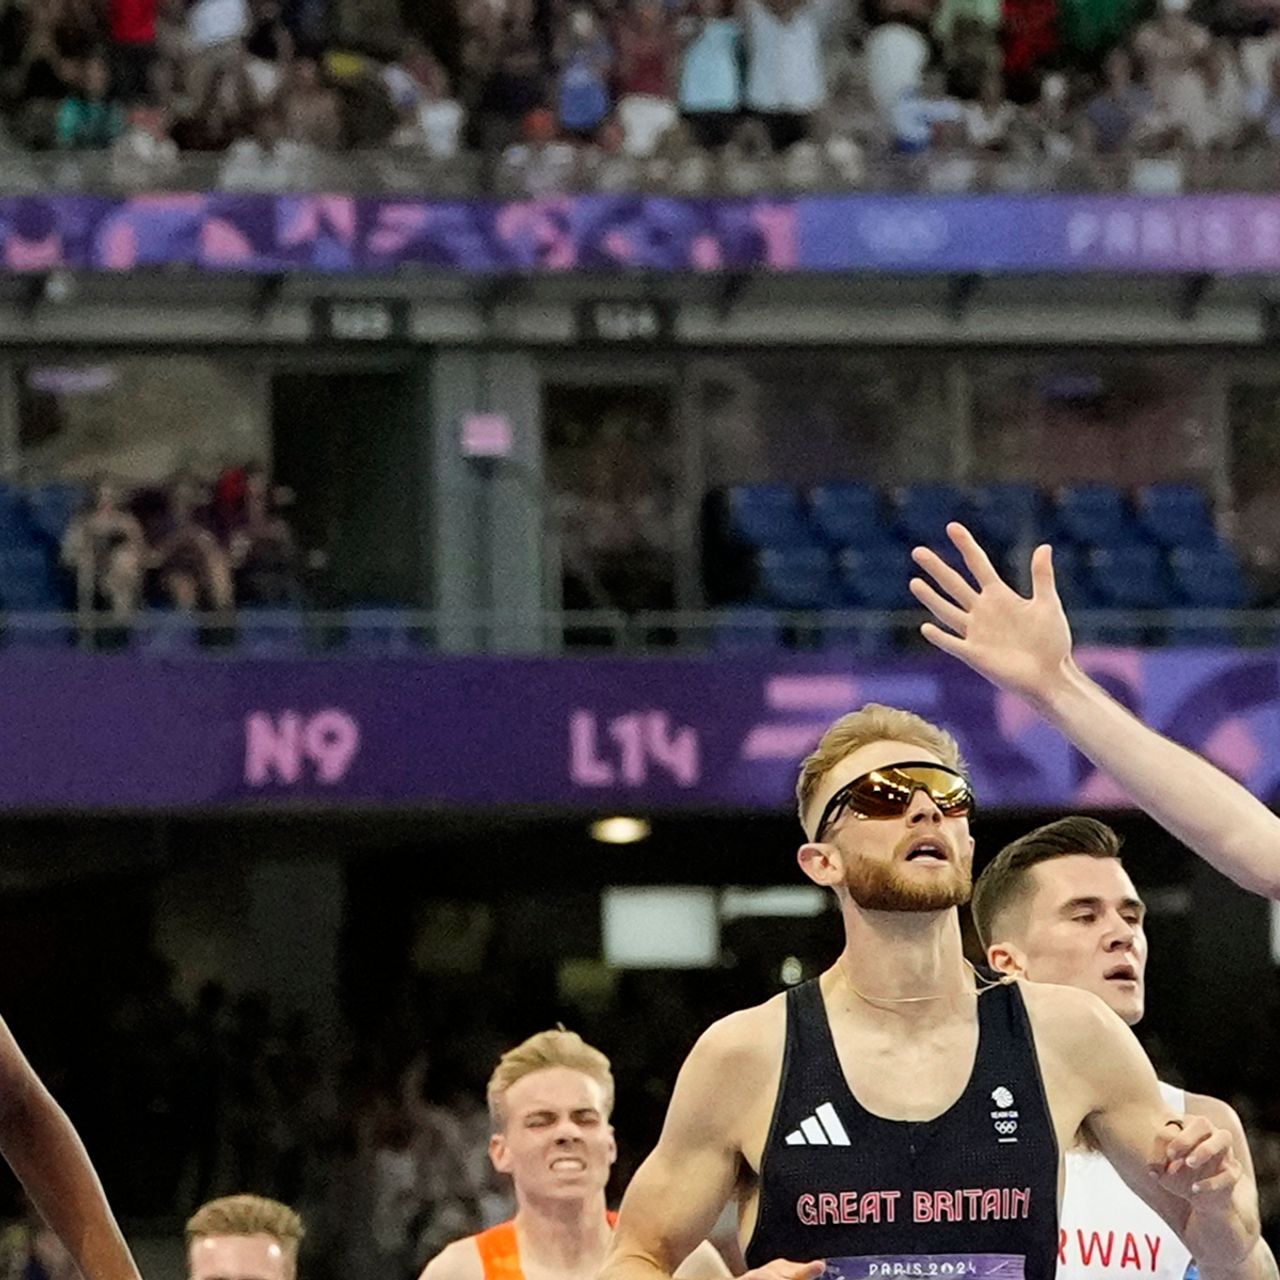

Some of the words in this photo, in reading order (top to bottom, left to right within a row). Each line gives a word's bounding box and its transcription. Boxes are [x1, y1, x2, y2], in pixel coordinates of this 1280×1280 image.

[243, 708, 361, 786] N9
[568, 708, 700, 786] L14
[797, 1189, 902, 1225] GREAT
[913, 1187, 1032, 1223] BRITAIN
[869, 1263, 923, 1276] PARIS
[927, 1260, 978, 1276] 2024
[1058, 1228, 1161, 1272] RWAY
